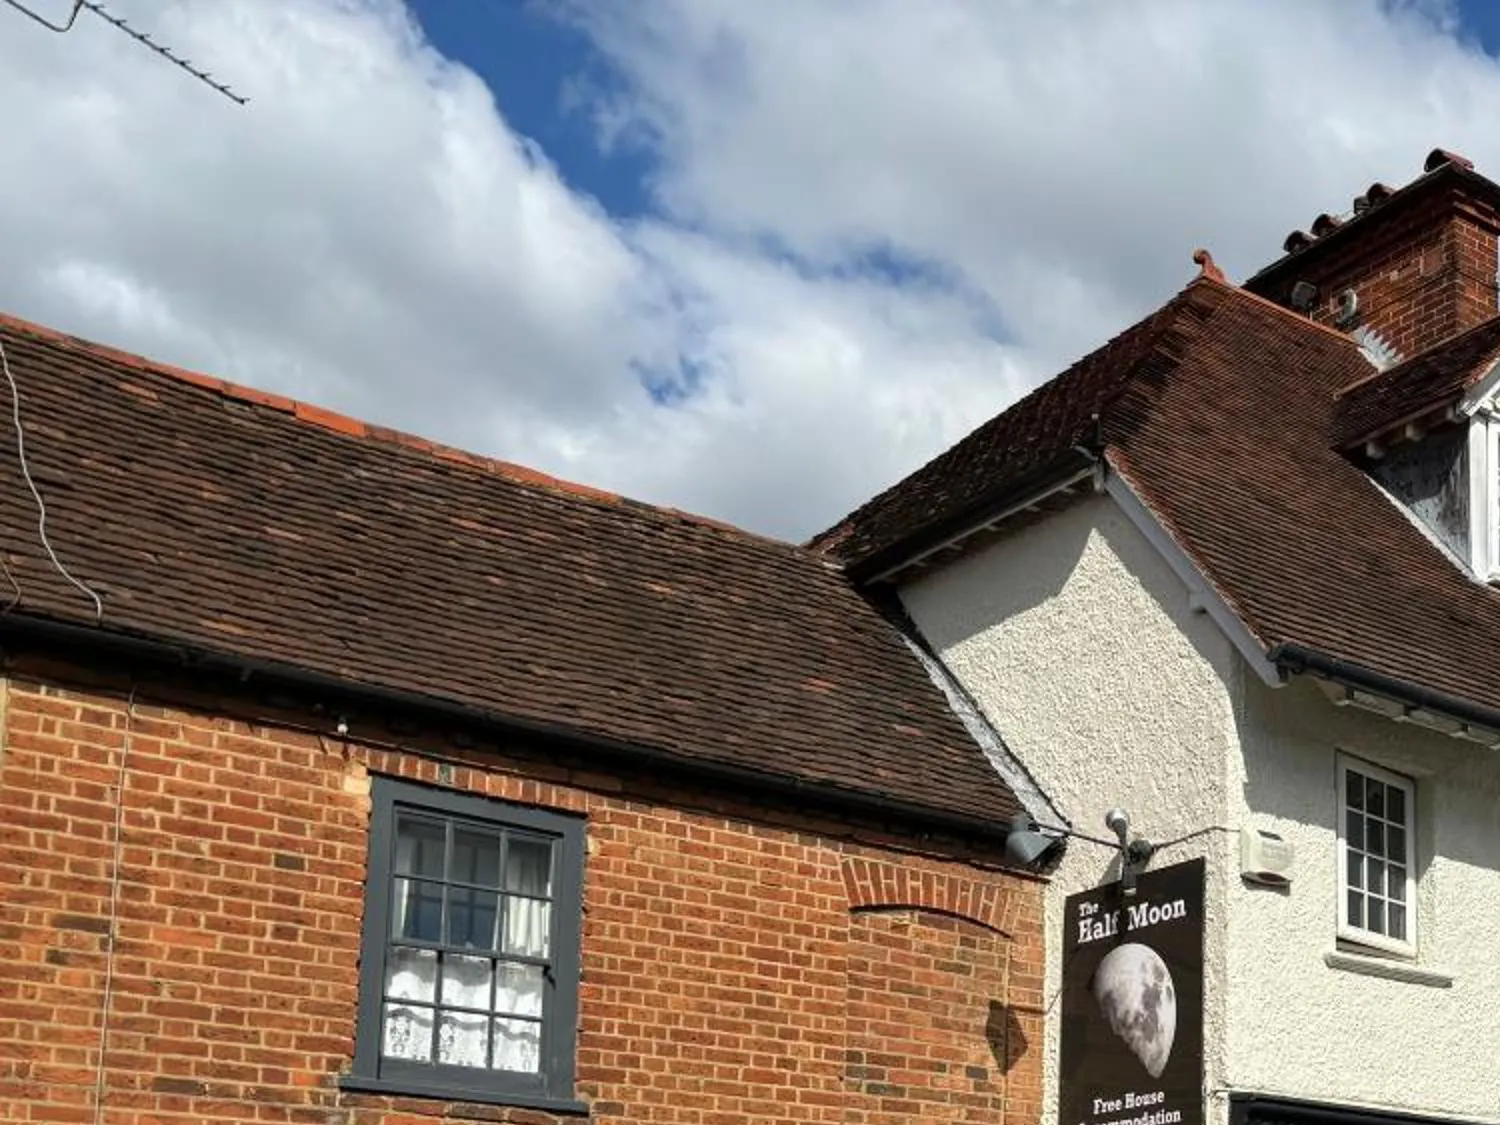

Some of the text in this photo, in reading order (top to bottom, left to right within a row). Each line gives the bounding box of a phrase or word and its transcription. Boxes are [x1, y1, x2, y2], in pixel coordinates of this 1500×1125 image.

[1077, 899, 1187, 944] Half Moon
[1078, 902, 1099, 917] The
[1093, 1090, 1165, 1115] Free House
